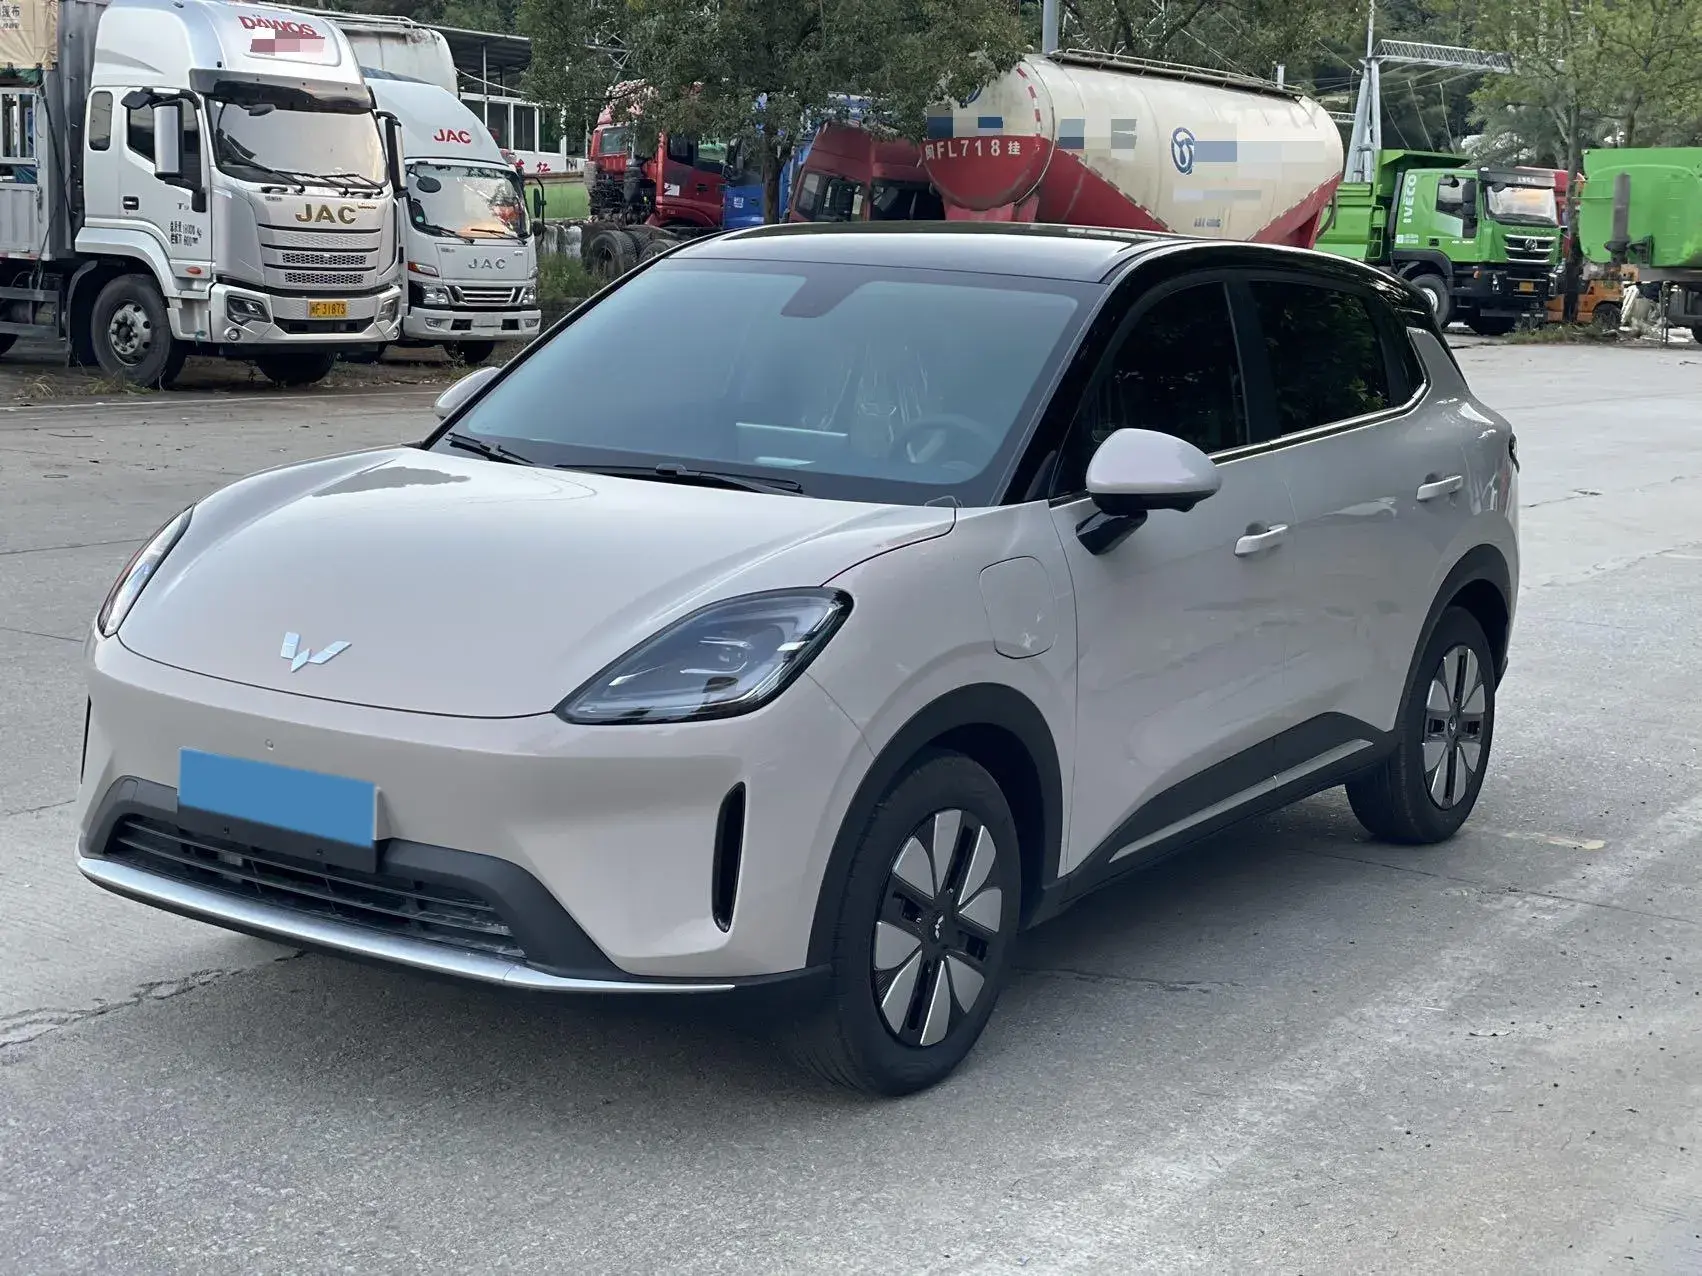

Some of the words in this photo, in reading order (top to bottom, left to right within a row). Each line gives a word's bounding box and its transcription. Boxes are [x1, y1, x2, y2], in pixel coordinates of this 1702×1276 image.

[433, 128, 472, 145] JAC
[1402, 174, 1418, 224] IVECO
[295, 203, 357, 225] JAC
[468, 258, 506, 270] JAC
